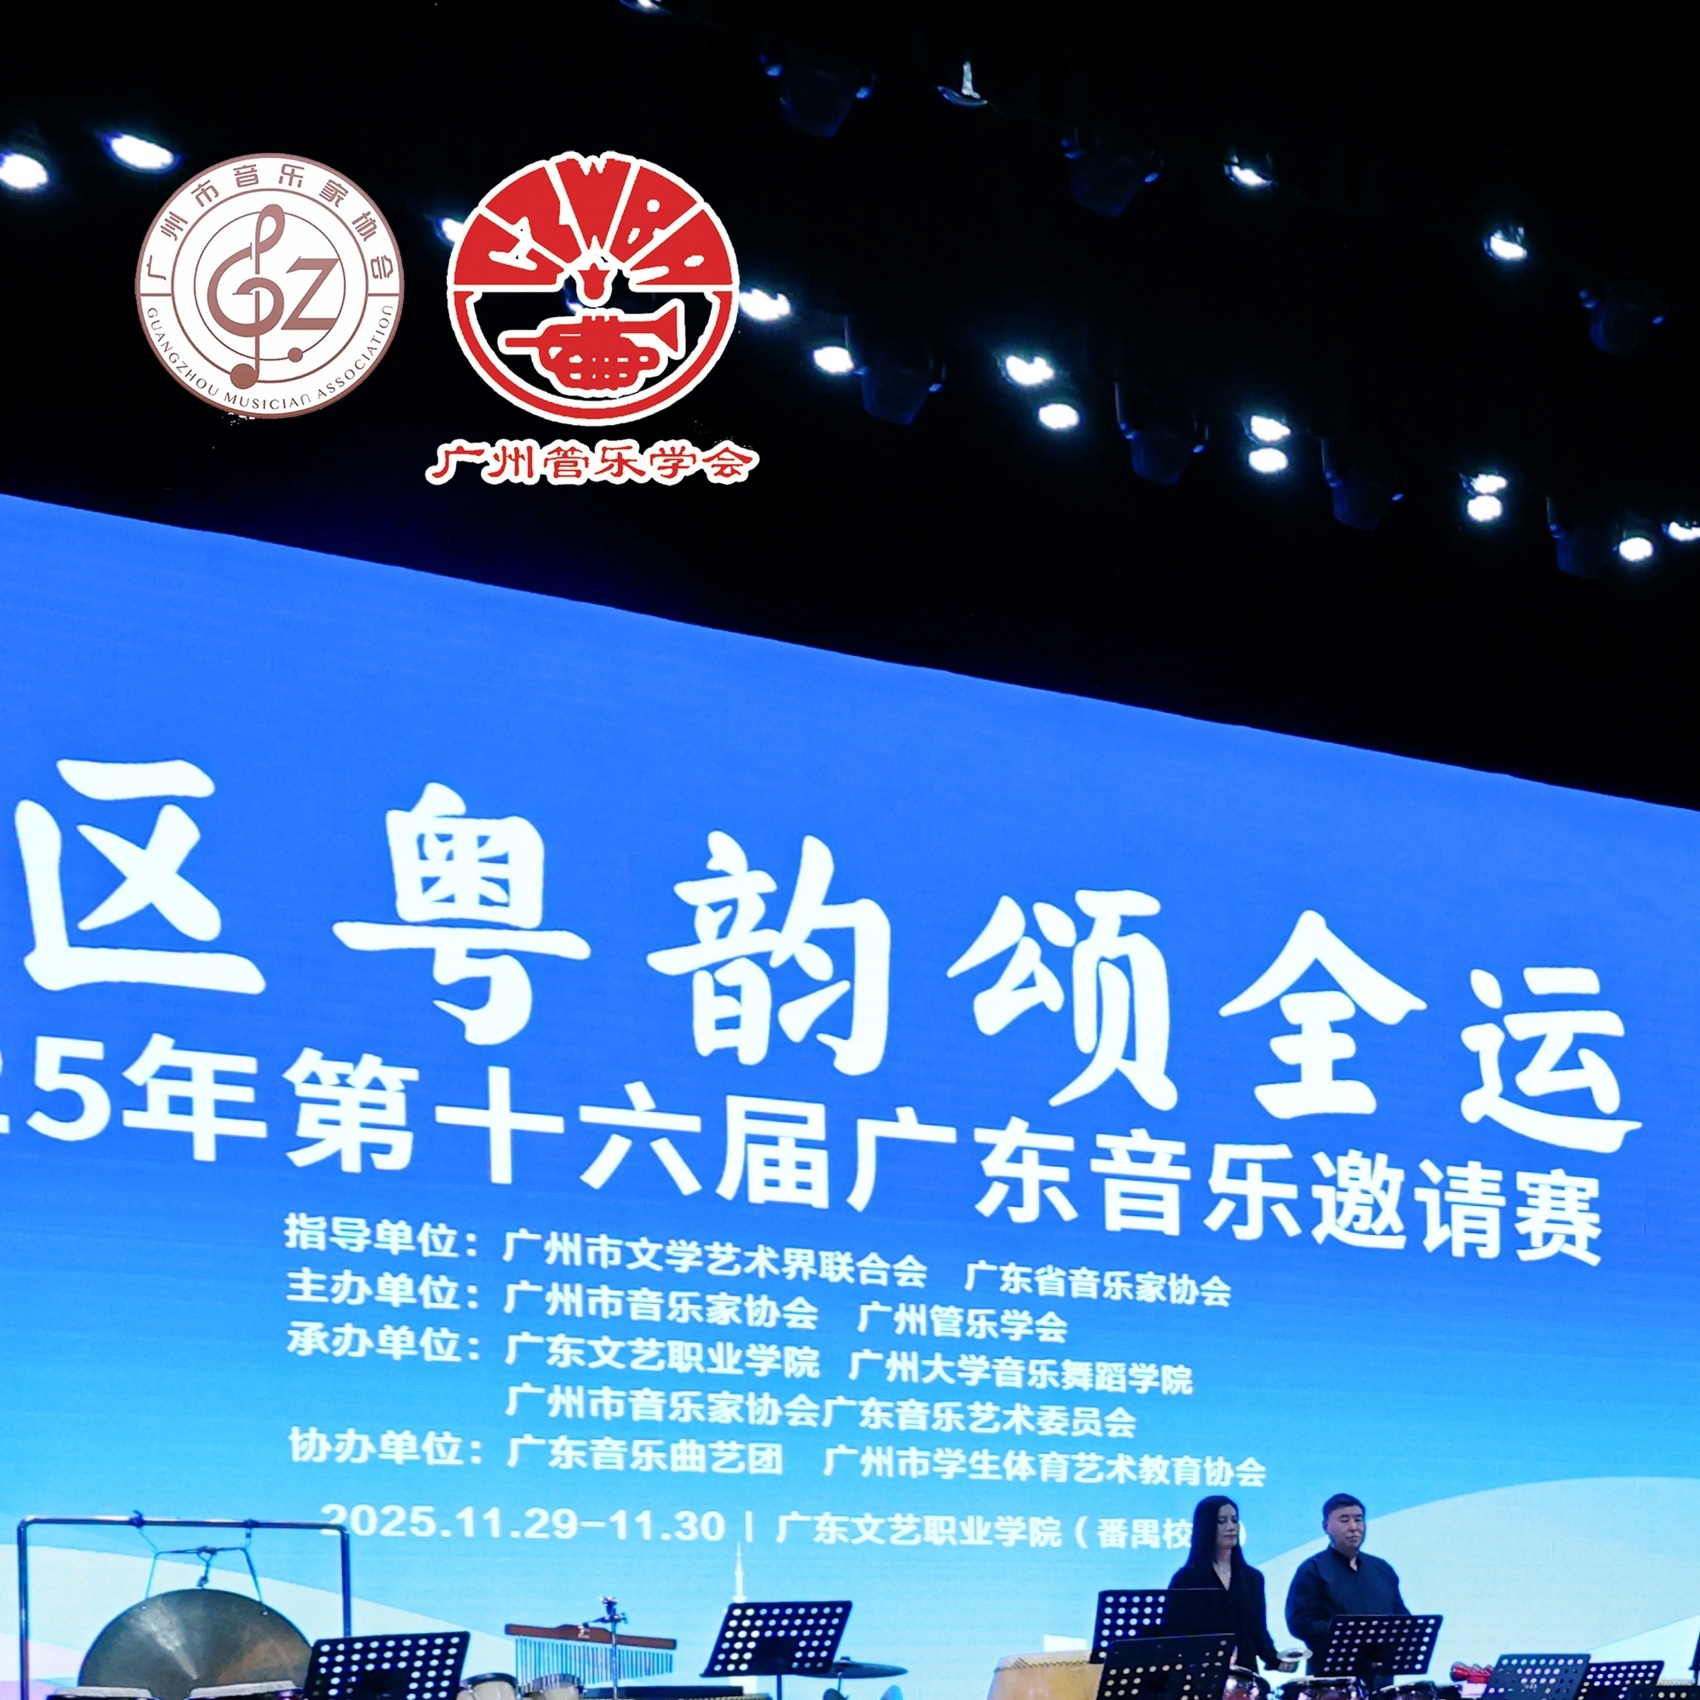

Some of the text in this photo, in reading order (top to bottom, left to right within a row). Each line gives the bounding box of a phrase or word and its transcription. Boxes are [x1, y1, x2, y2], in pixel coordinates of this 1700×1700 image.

[0, 1033, 1603, 1267] 5年第十六届广东音乐邀请赛
[284, 1212, 1232, 1308] 指导单位： 广州市文学艺术界联合会 广东省音乐家协会
[285, 1267, 1069, 1344] 主办单位： 广州市音乐家协会 广州管乐学会
[286, 1320, 1194, 1396] 承办单位： 广东文艺职业学院 广州大学音乐舞蹈学院
[505, 1382, 1137, 1440] 广州市音乐家协会广东音乐艺术委员会
[288, 1426, 1267, 1488] 协办单位： 广东音乐曲艺团 广州市学生体育艺术教育协会
[776, 1511, 1247, 1550] 广东文艺职业学院（番禺校）
